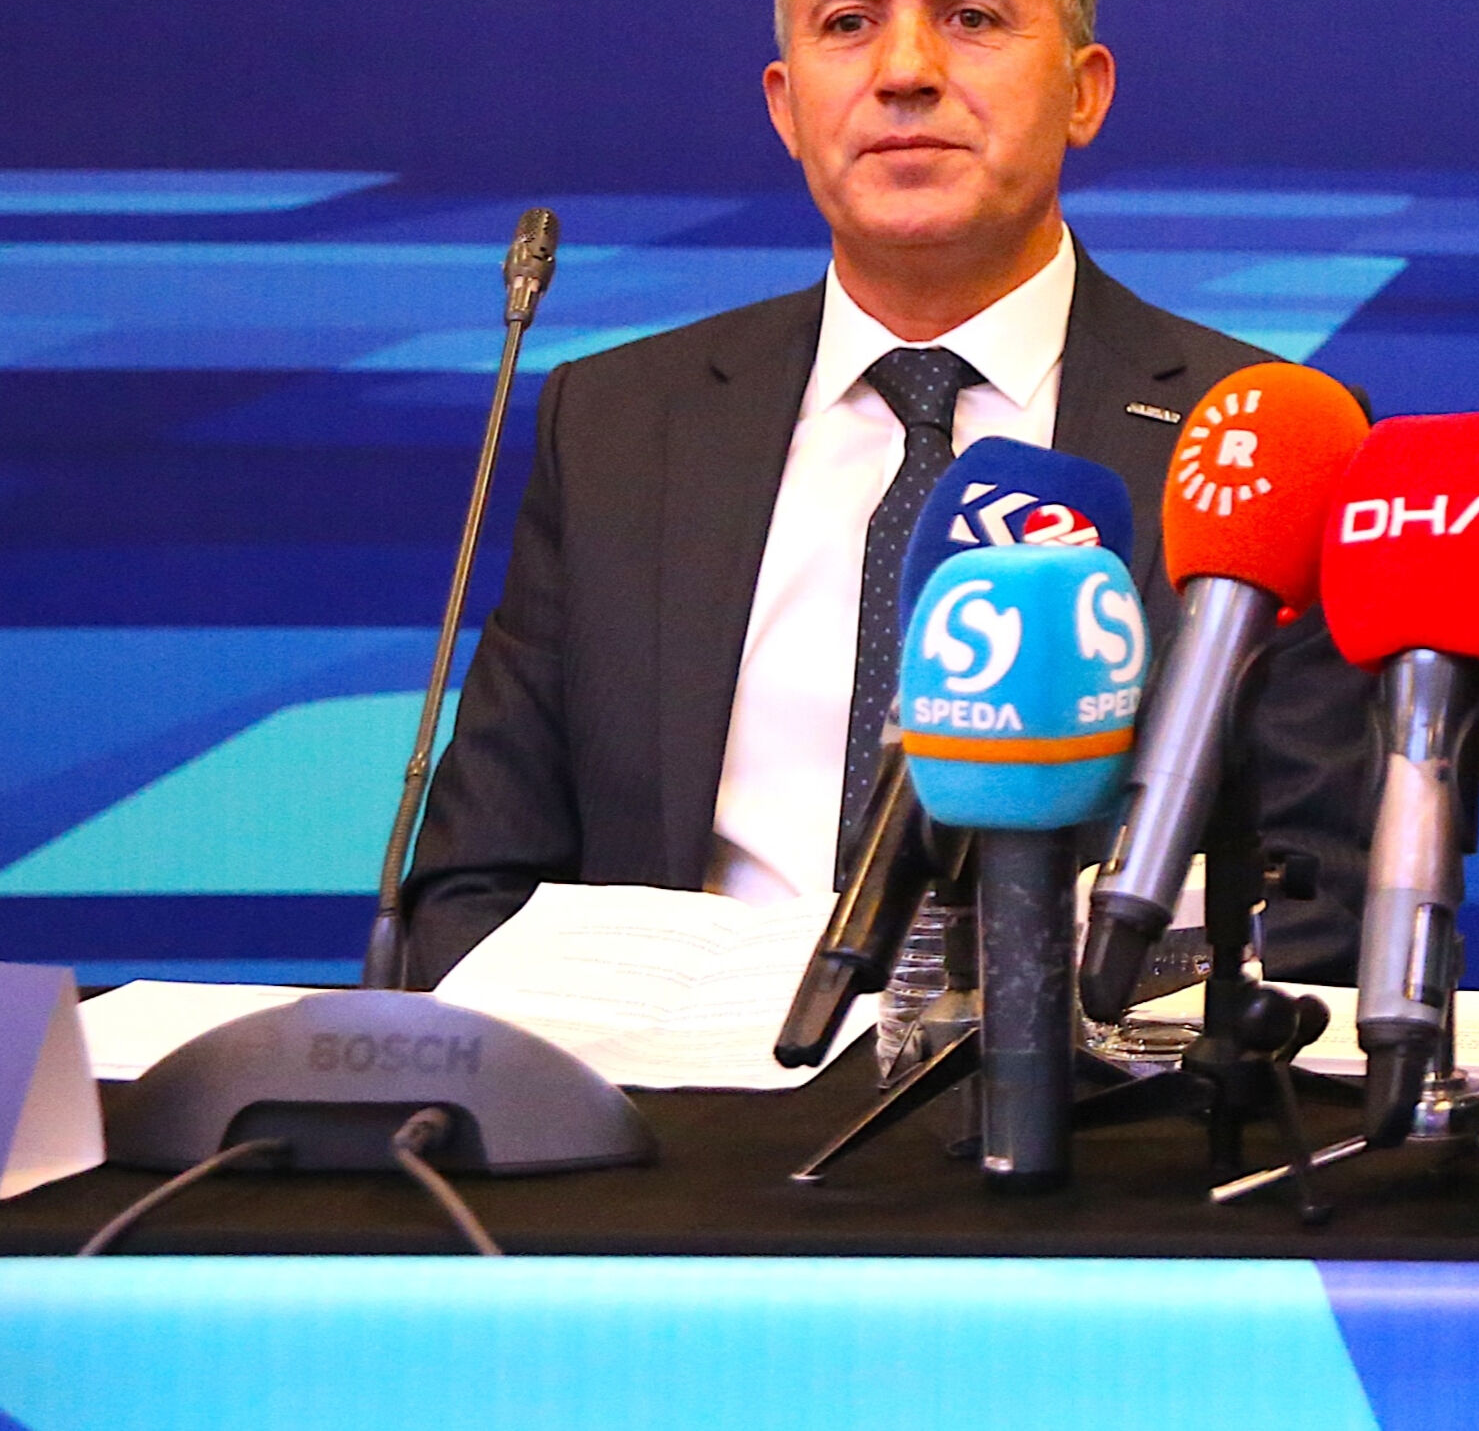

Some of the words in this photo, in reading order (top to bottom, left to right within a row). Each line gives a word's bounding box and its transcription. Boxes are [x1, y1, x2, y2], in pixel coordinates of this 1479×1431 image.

[914, 696, 1024, 731] SPEDA
[1078, 684, 1141, 724] SPED
[308, 1032, 484, 1074] BOSCH
